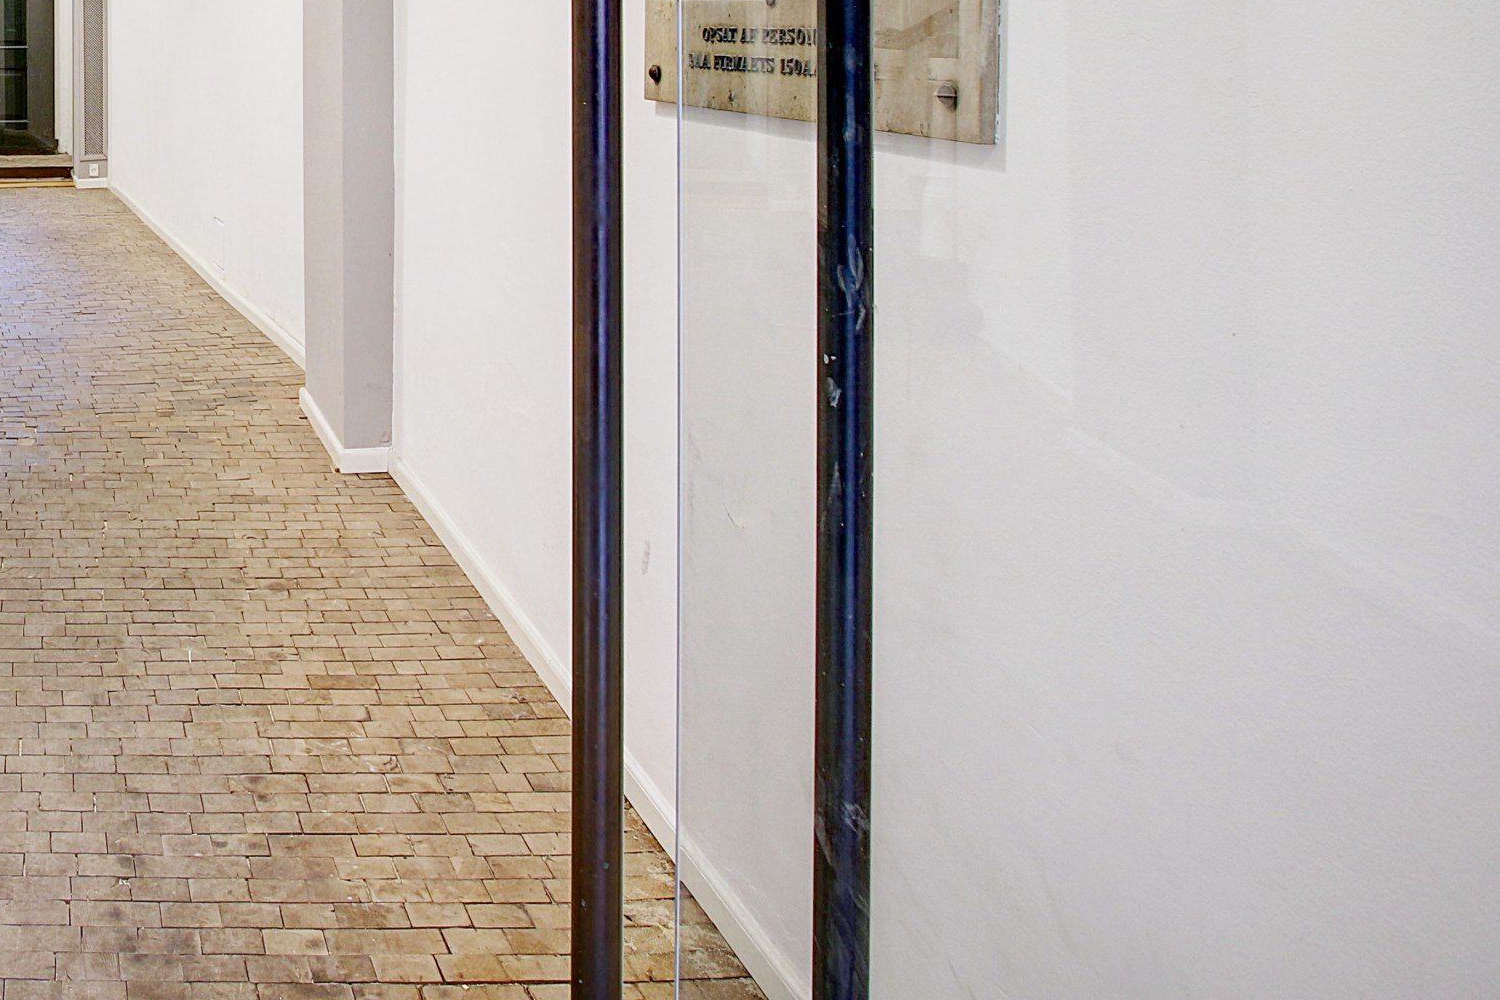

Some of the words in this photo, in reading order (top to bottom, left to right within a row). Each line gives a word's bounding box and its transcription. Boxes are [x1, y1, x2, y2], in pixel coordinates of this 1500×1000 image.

[702, 26, 737, 44] OPSAT
[740, 27, 757, 45] AF
[713, 54, 774, 76] FIRMAETS
